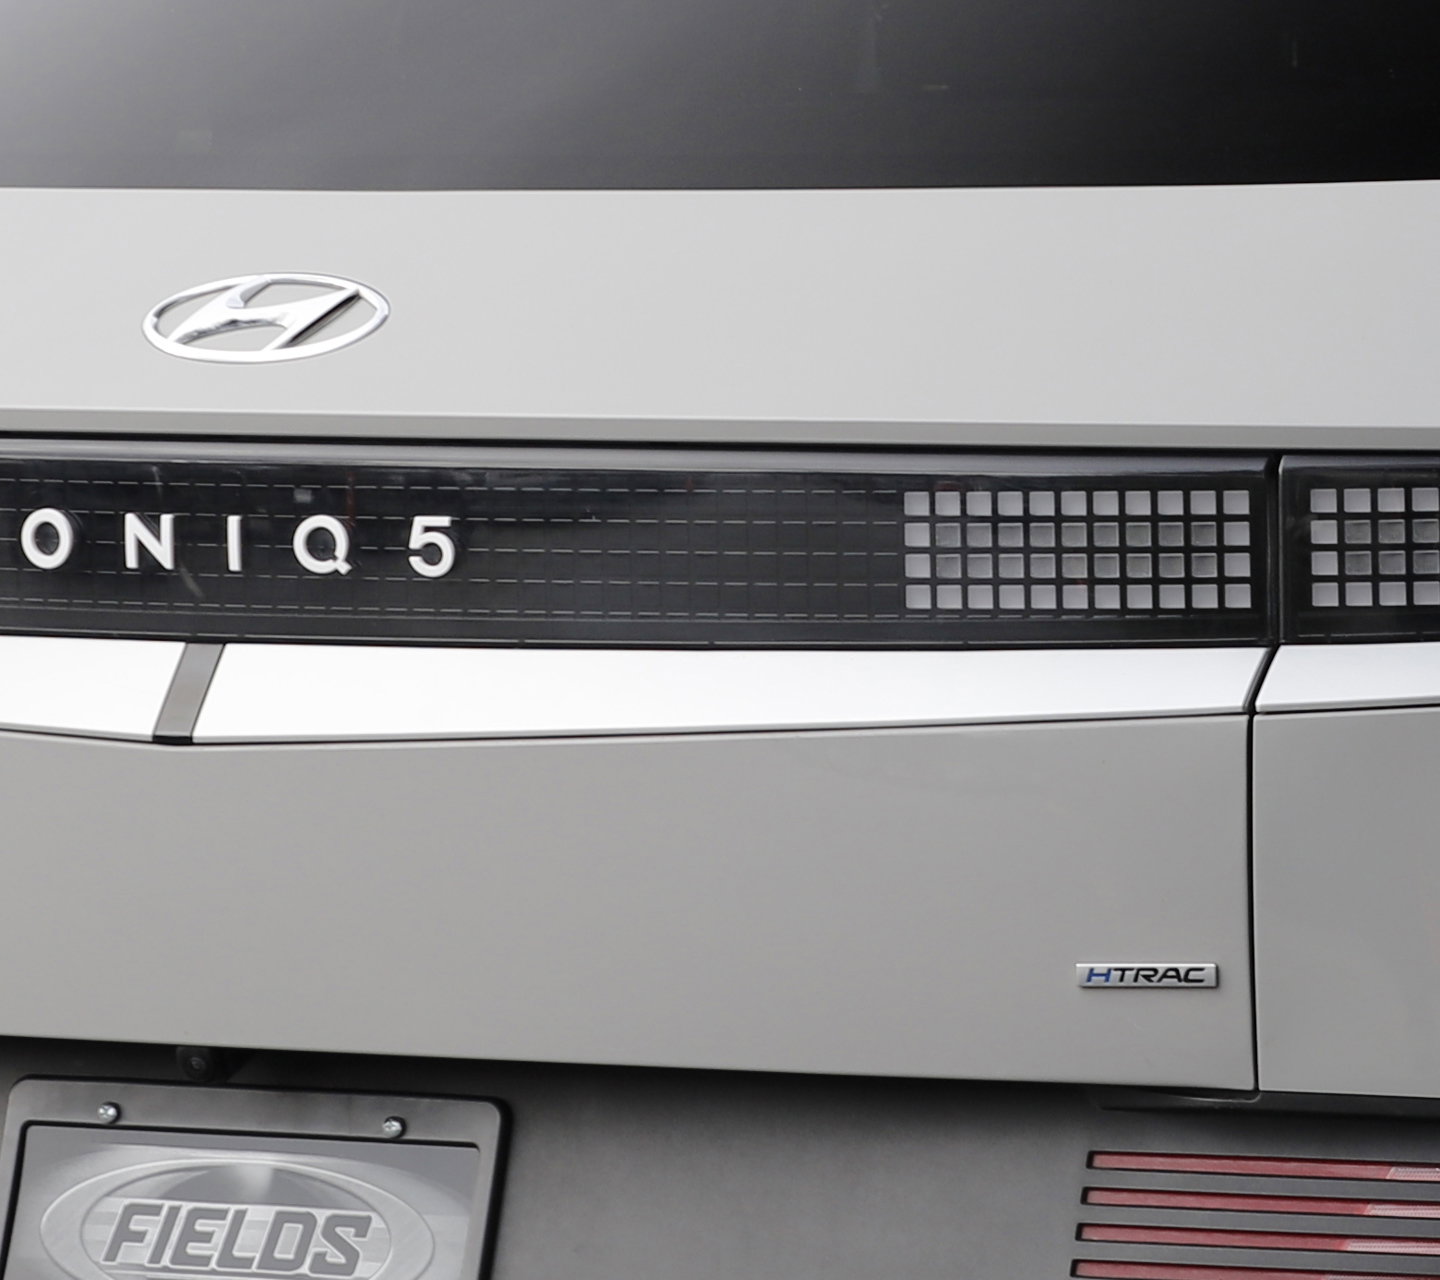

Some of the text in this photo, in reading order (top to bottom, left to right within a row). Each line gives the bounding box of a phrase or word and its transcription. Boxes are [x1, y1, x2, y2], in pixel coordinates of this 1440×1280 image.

[407, 514, 457, 579] 5
[1085, 967, 1206, 984] HTRAC
[100, 1200, 373, 1278] FIELDS
